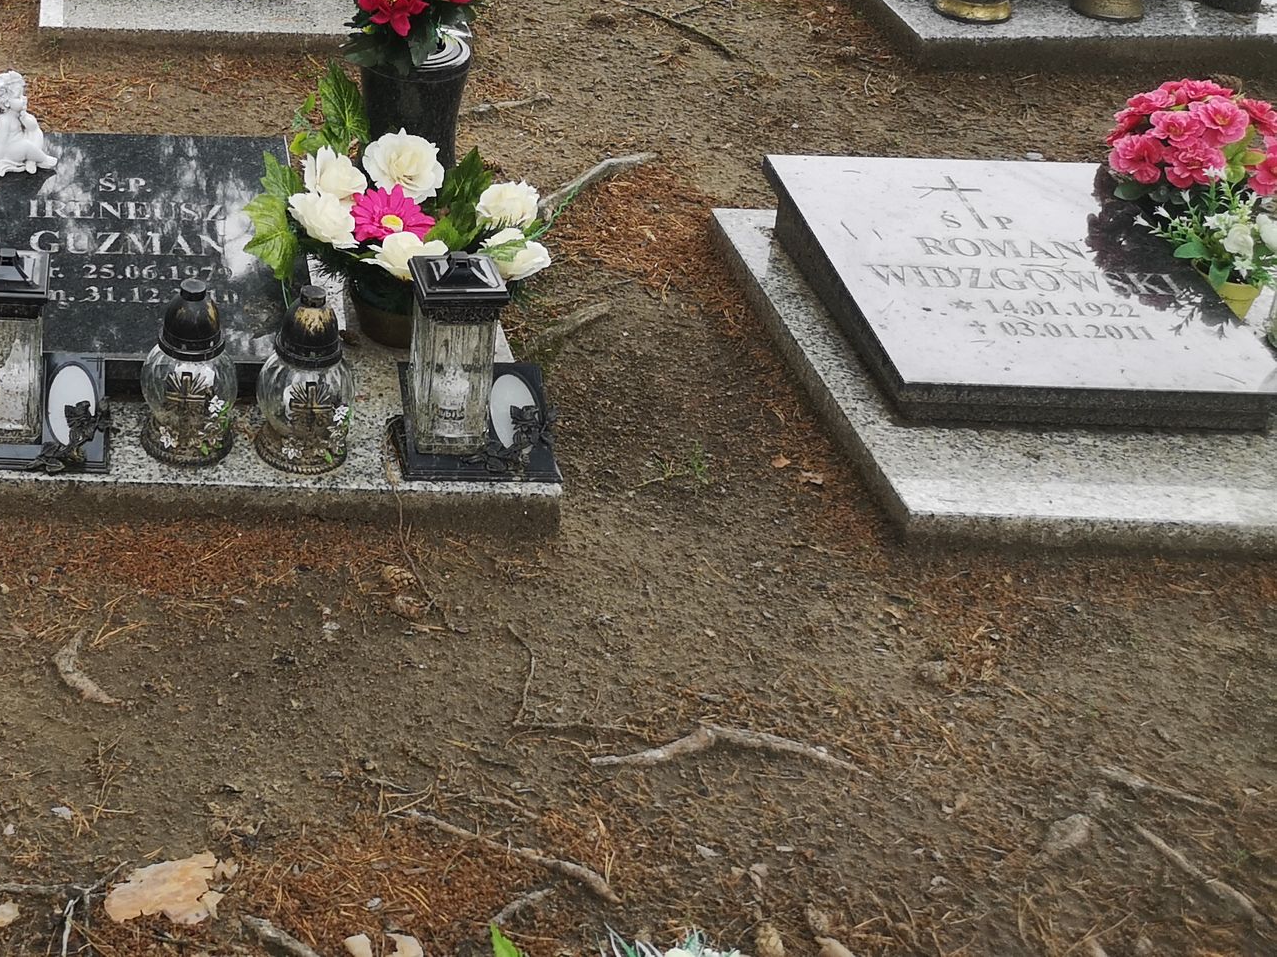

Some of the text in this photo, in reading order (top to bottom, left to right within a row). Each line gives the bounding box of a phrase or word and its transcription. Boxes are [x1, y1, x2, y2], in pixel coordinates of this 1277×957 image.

[27, 199, 227, 221] IRENEUSZ
[992, 215, 1013, 230] P
[913, 236, 1087, 261] ROMAN
[861, 263, 1187, 296] WIDZGOWSKI
[984, 298, 1141, 319] 14.01.1922
[998, 321, 1156, 341] 03.01.2011
